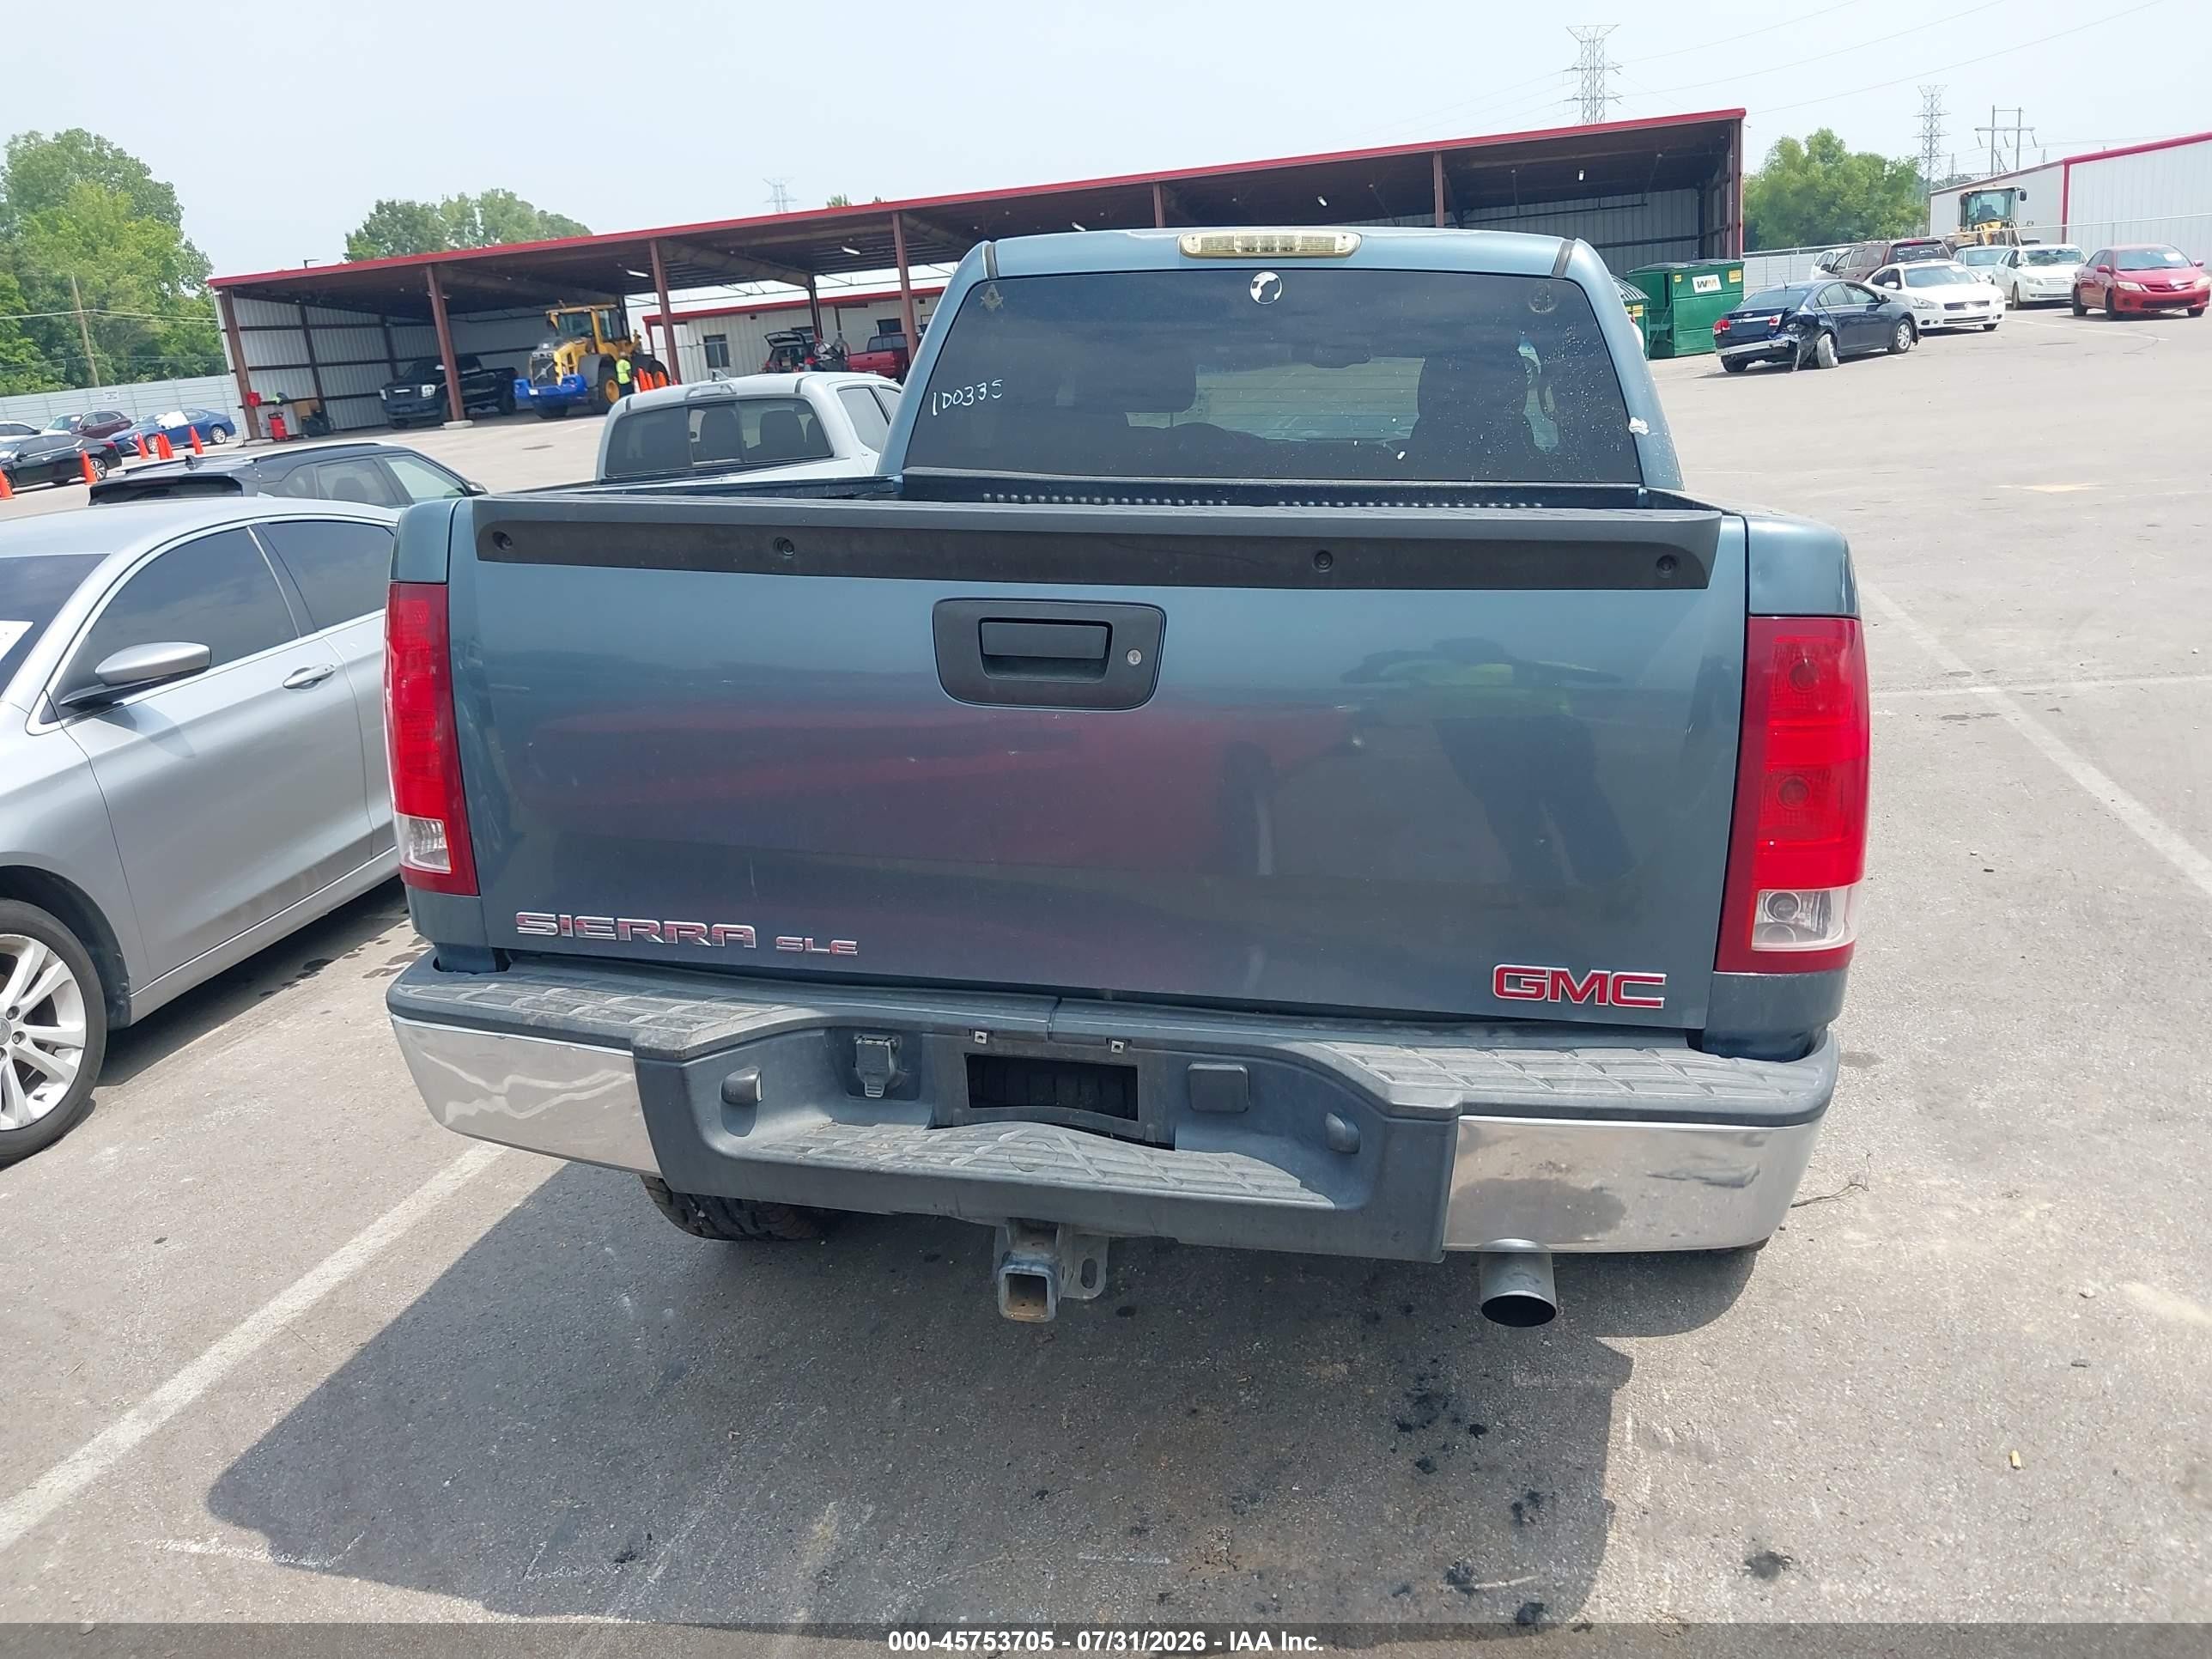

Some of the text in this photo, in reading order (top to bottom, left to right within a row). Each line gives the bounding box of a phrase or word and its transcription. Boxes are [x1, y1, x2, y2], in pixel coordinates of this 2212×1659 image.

[1696, 278, 1718, 289] WM
[515, 911, 859, 956] SIERRA SLE
[1492, 963, 1668, 1009] GMC
